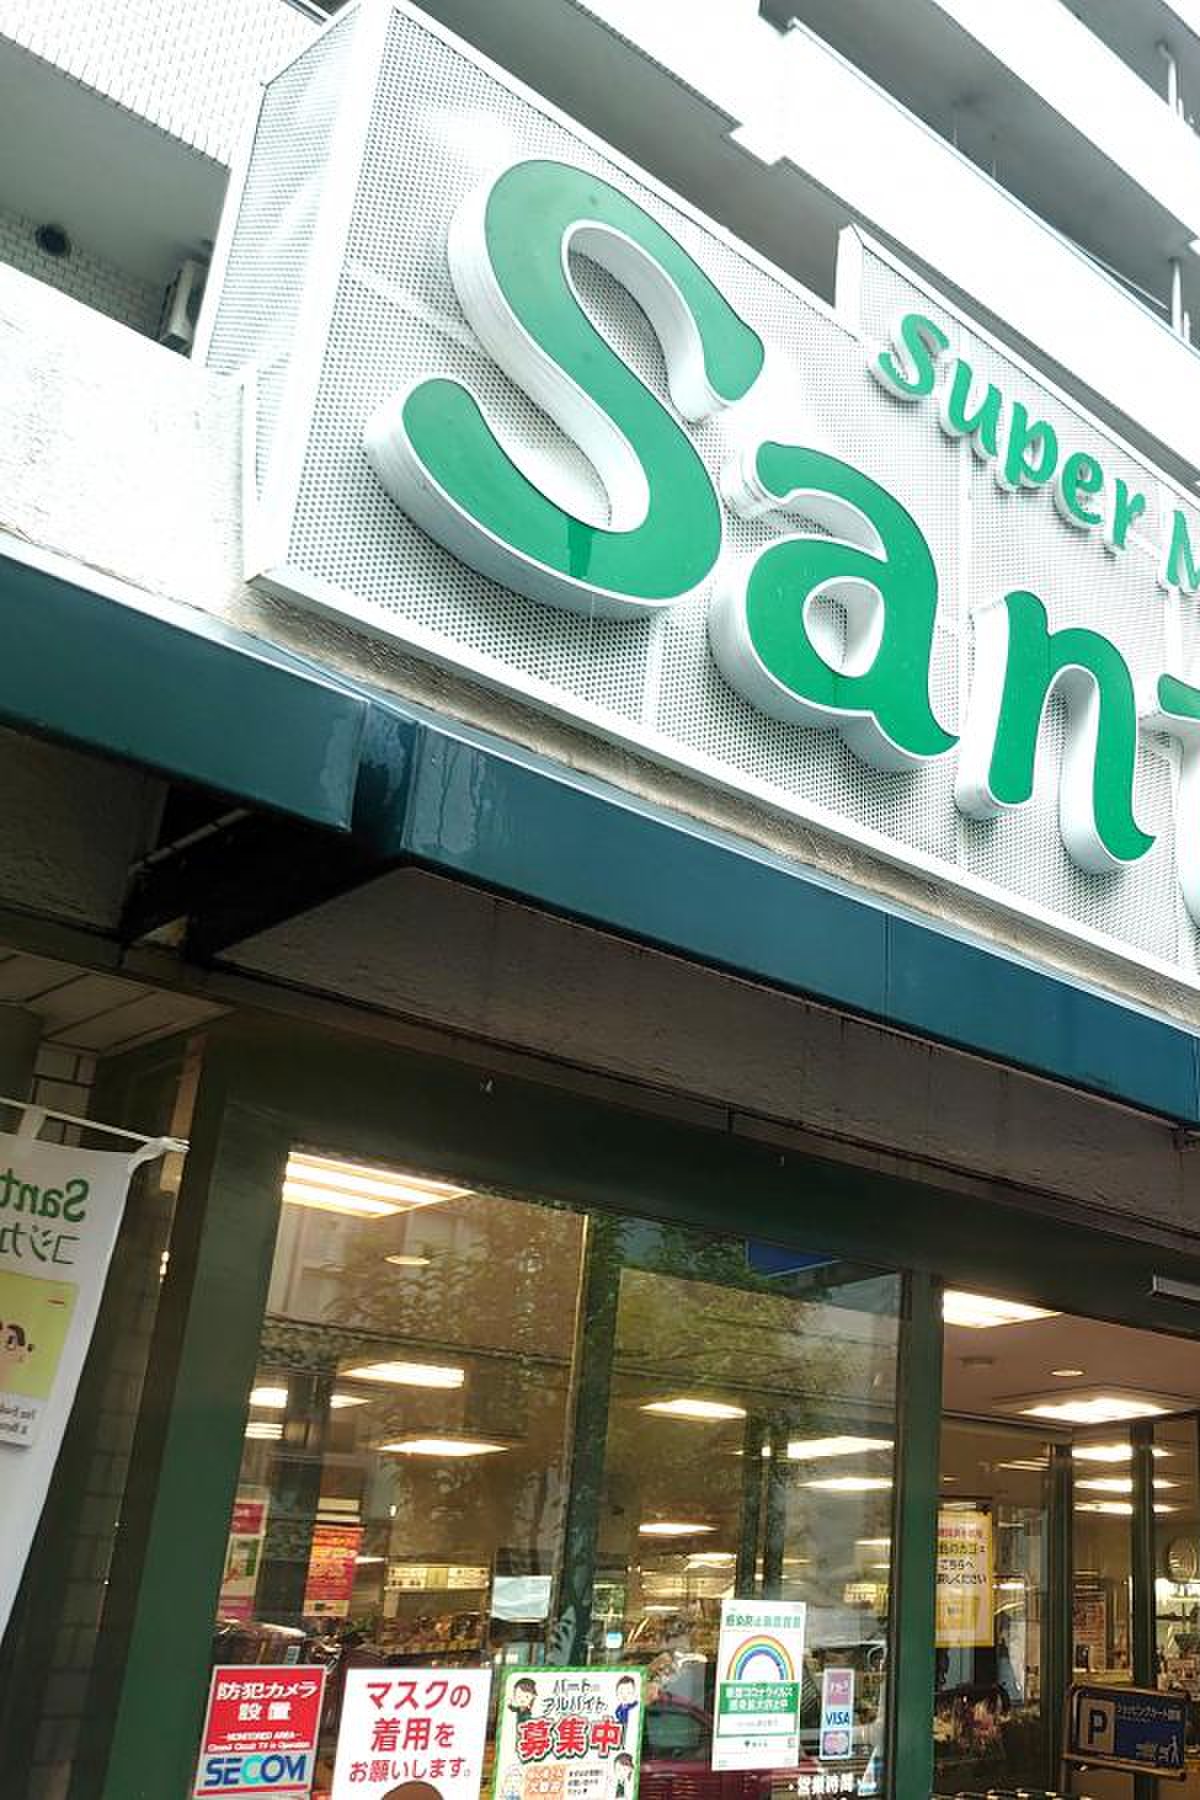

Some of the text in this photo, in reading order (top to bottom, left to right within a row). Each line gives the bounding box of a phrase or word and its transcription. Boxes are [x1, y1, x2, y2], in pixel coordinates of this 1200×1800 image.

[872, 312, 1148, 553] Super
[216, 1680, 318, 1701] 防犯カメラ
[365, 1680, 472, 1711] マスクの
[370, 1716, 456, 1752] 着用を
[518, 1716, 624, 1761] 募集中
[1088, 1708, 1109, 1745] P
[204, 1753, 308, 1787] SECOM
